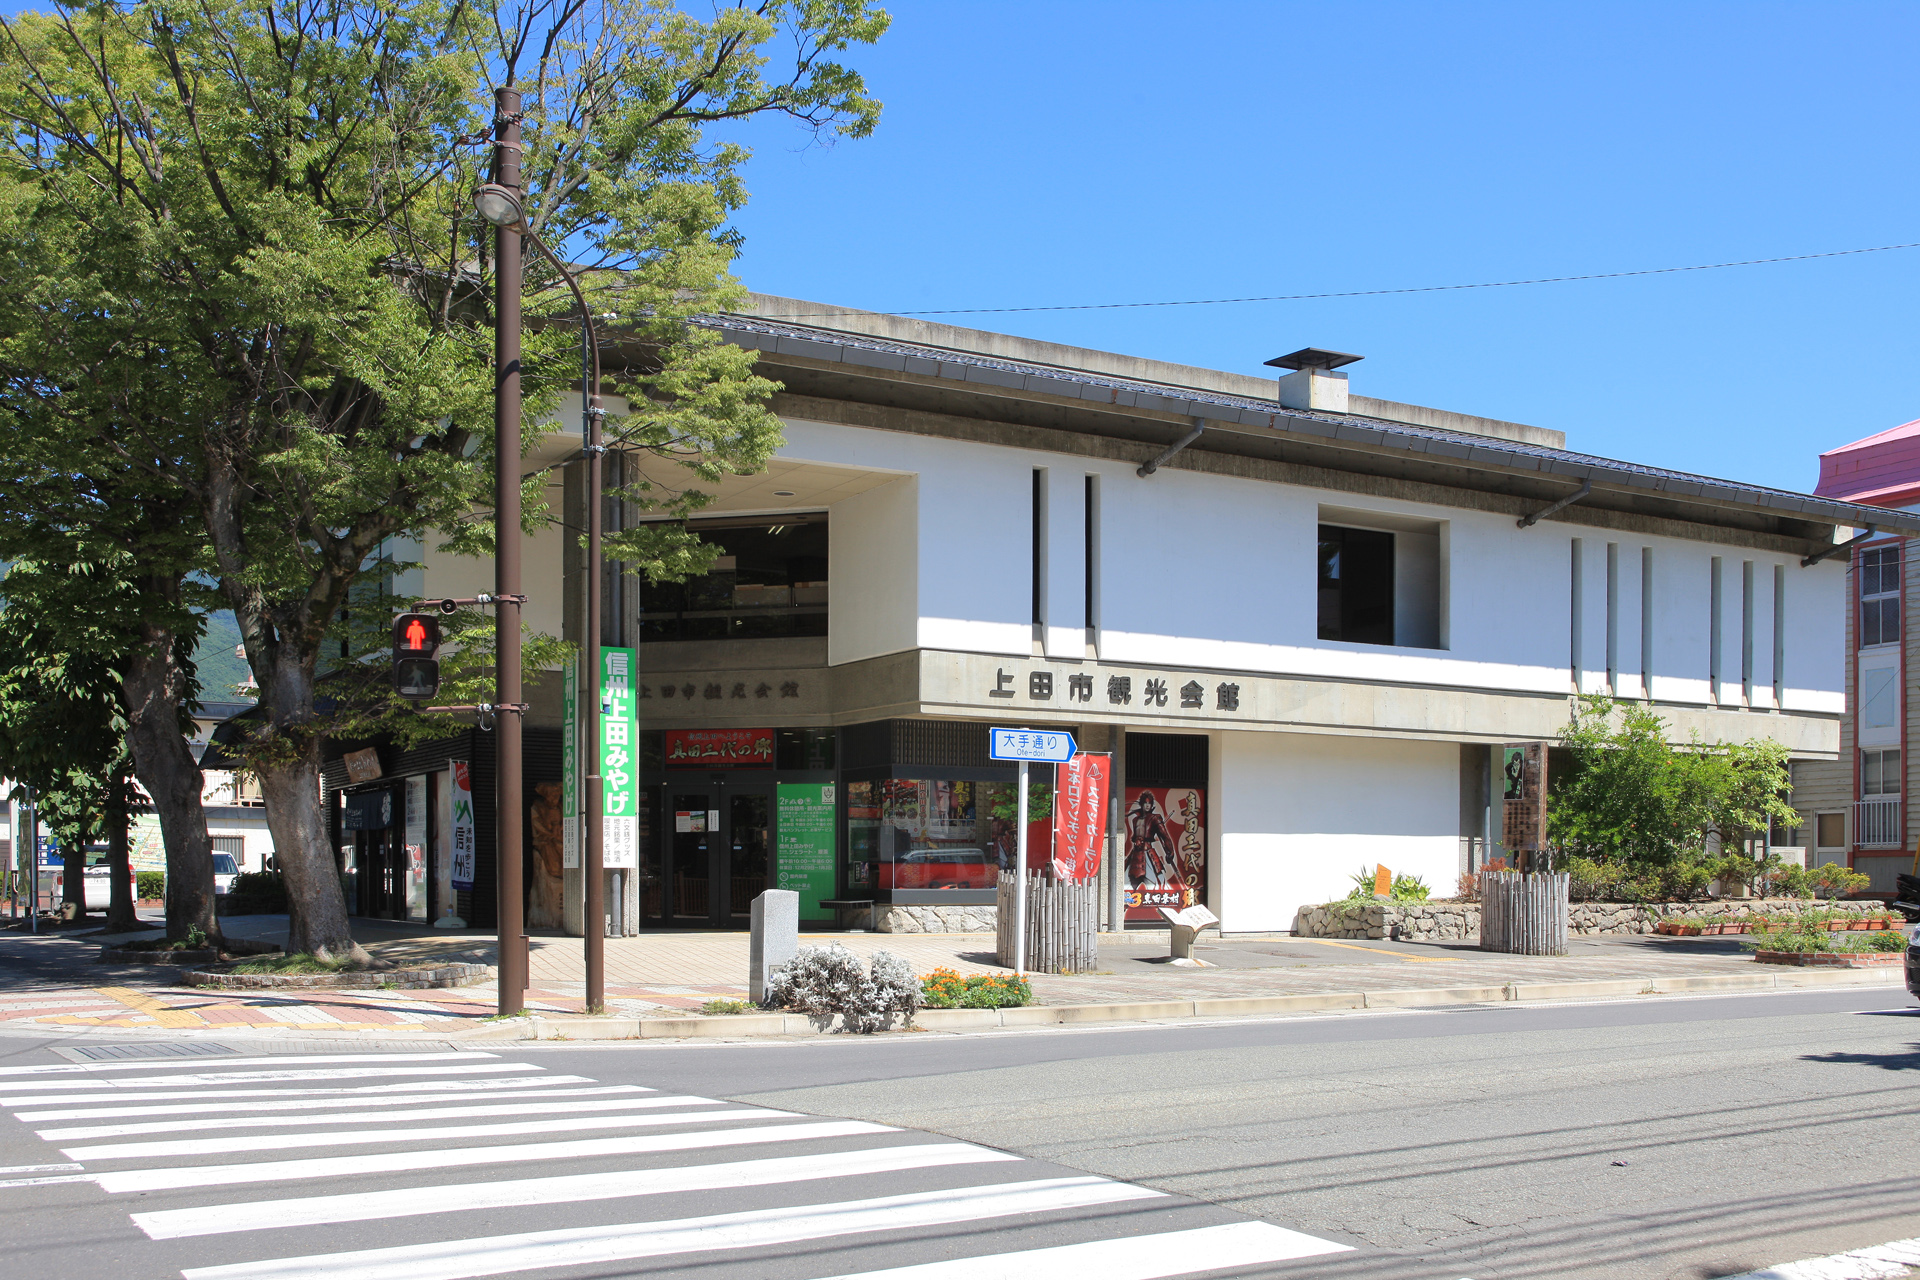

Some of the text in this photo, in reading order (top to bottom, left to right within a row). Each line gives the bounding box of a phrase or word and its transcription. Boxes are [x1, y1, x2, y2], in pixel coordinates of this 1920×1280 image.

[989, 667, 1240, 711] 上田市観光会館
[605, 651, 629, 815] 信州上田みやげ
[687, 731, 752, 741] 信州上田へようこそ
[1003, 733, 1058, 750] 大手通り
[669, 736, 773, 761] 真田三代の郷
[1016, 748, 1046, 757] Ote-dori
[779, 797, 789, 805] 2F
[780, 834, 789, 843] 1F
[1180, 790, 1202, 908] 真田三代の郷
[454, 826, 466, 878] 信州
